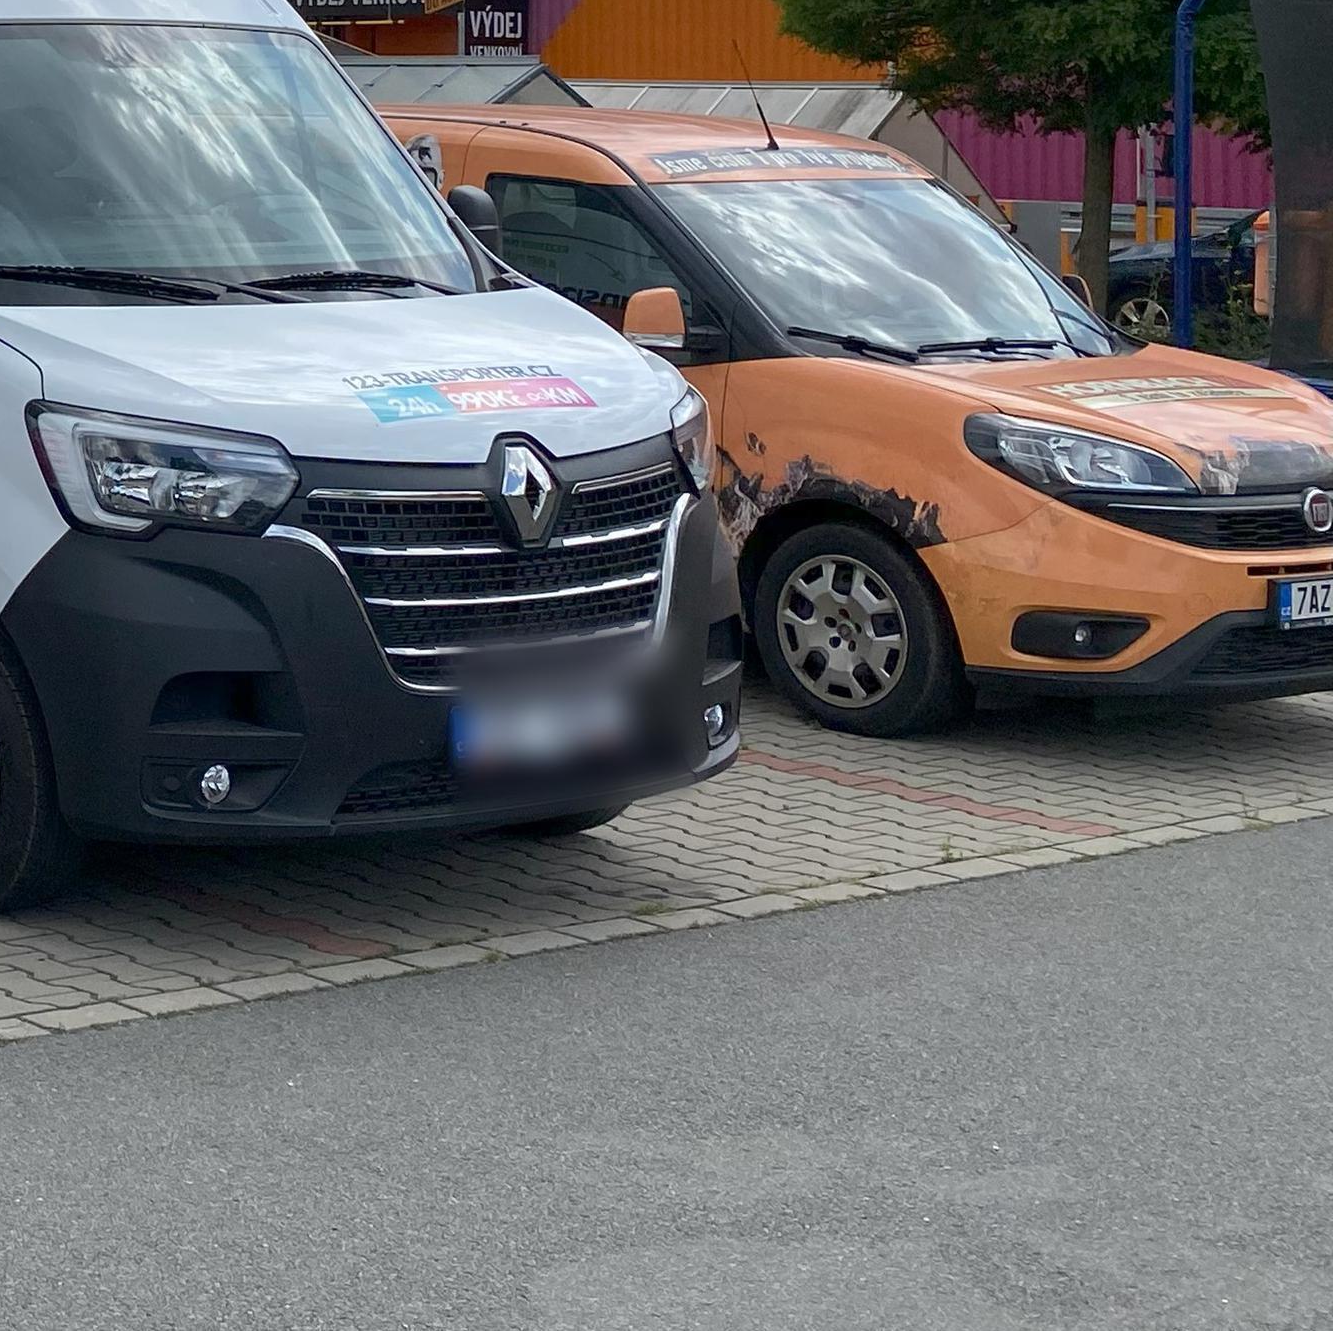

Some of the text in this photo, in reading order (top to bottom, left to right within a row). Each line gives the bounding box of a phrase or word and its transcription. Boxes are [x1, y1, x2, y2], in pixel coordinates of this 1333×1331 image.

[469, 5, 523, 39] VÝDEJ
[341, 365, 563, 391] 123-TRANSPORTER.CZ
[387, 396, 443, 418] 24h
